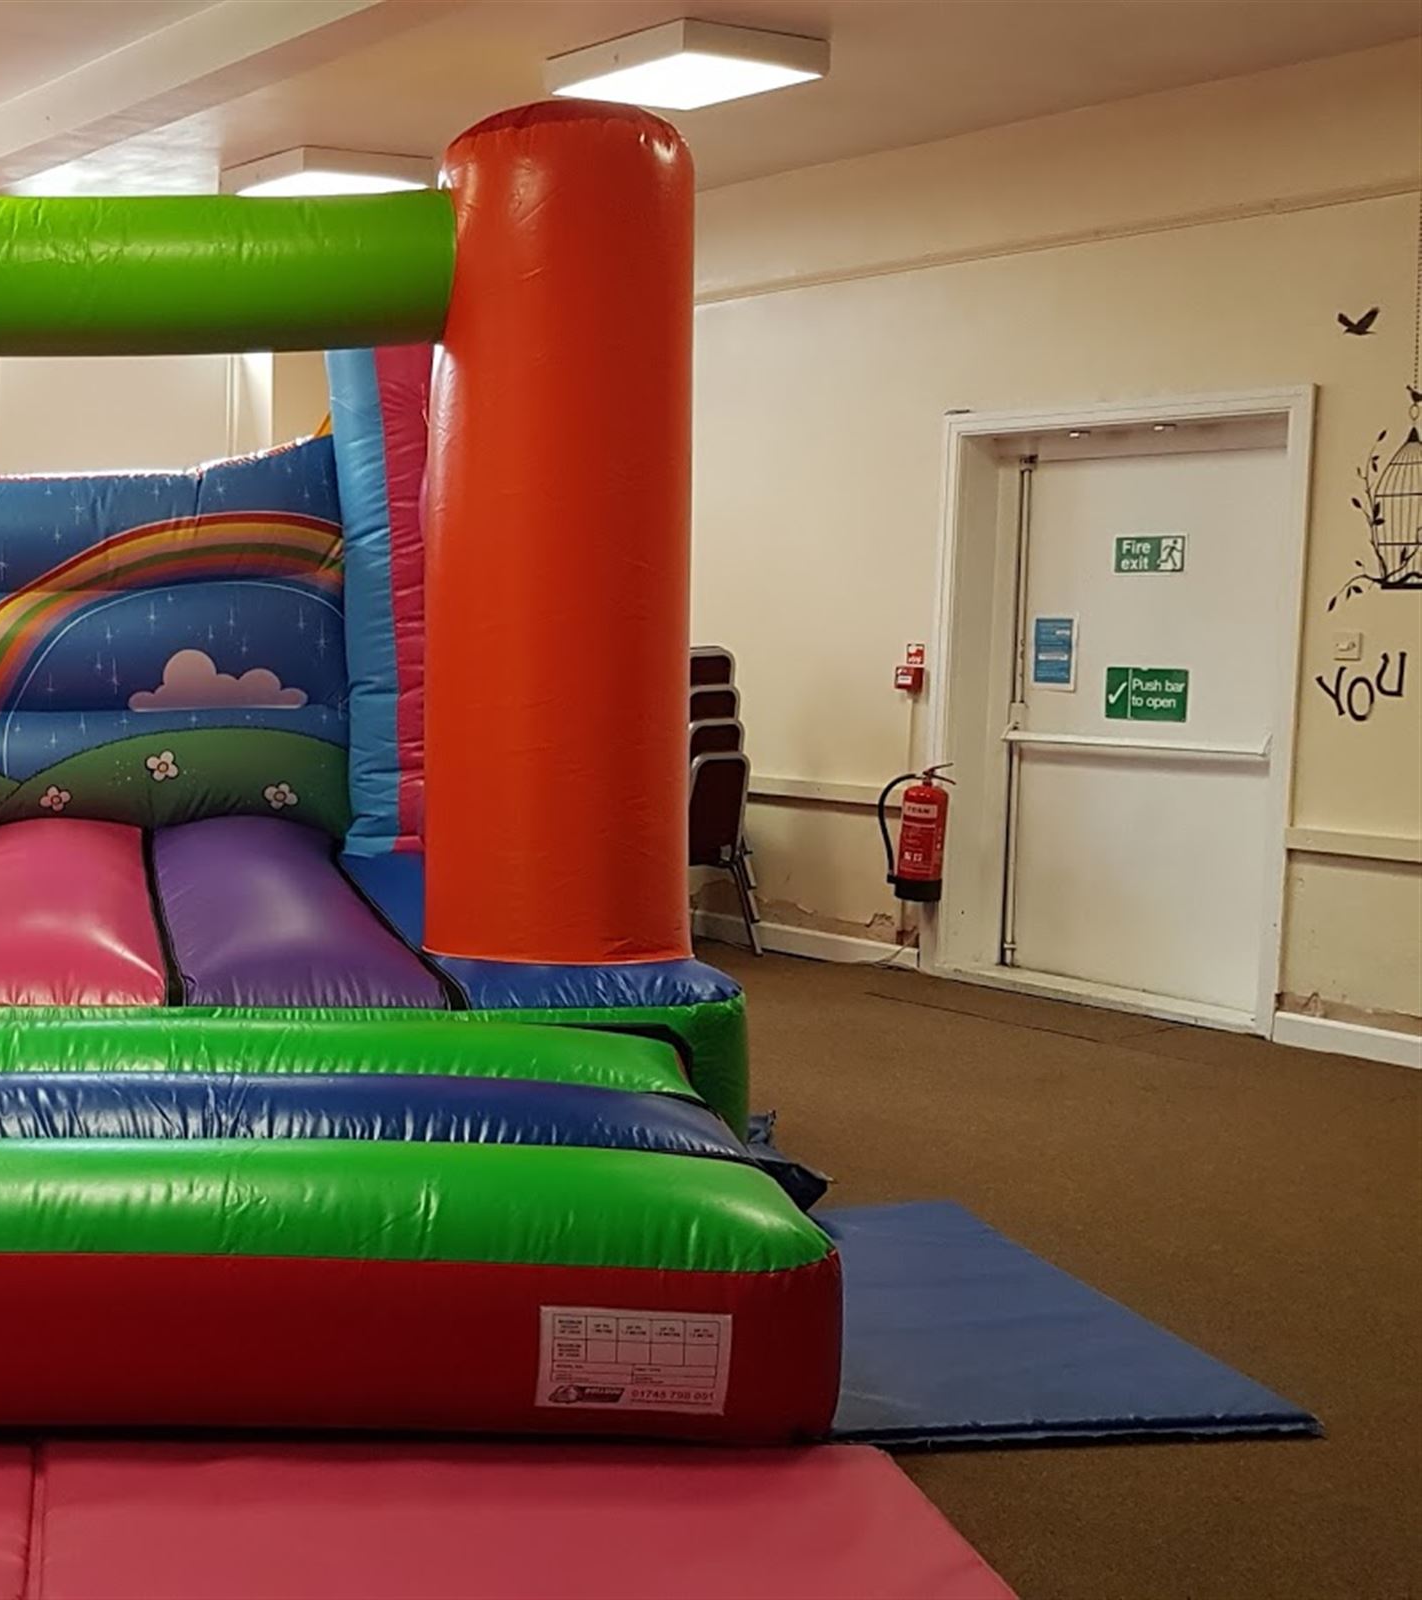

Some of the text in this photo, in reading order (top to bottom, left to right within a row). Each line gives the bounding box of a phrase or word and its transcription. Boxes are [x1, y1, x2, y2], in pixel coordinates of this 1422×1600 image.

[1122, 539, 1151, 554] Fire
[1121, 555, 1149, 570] exit
[1132, 678, 1186, 693] Push bar
[1315, 652, 1407, 721] YOU
[1132, 695, 1176, 710] to open
